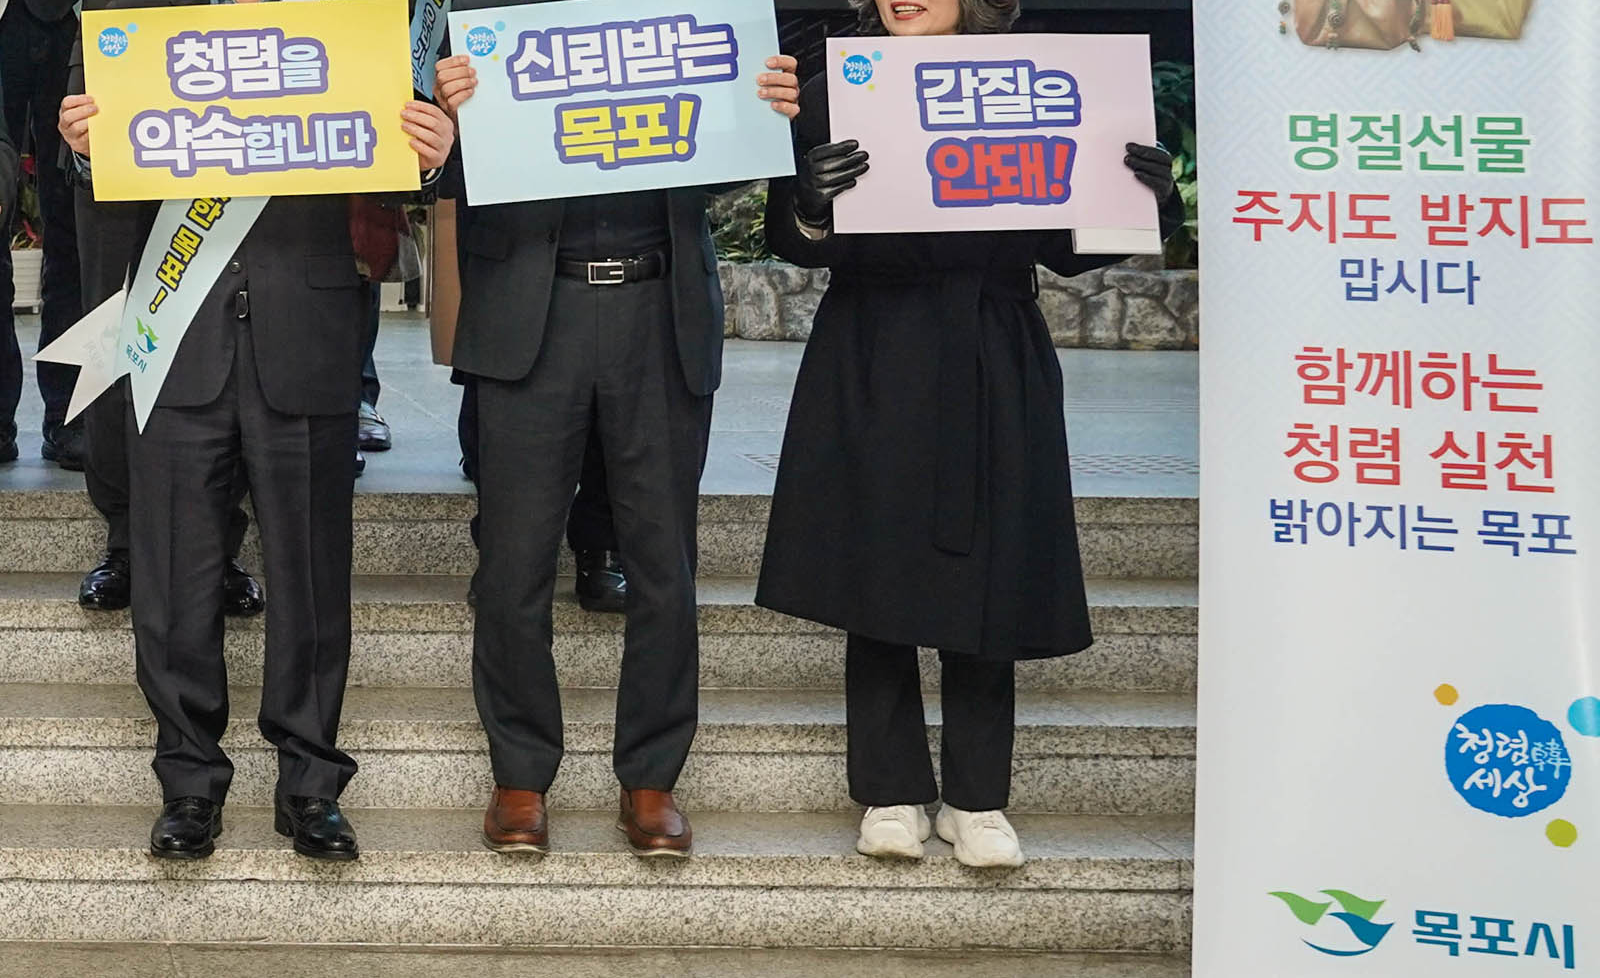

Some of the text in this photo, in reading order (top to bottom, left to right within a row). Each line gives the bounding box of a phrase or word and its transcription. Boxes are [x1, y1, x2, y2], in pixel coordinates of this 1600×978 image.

[173, 35, 323, 95] 청렴을
[512, 21, 733, 95] 신뢰받는
[921, 67, 1075, 125] 갑질은
[135, 112, 371, 171] 약속합니다
[560, 100, 695, 164] 목포!
[1288, 112, 1531, 174] 명절선물
[933, 142, 1071, 201] 안돼!
[1232, 189, 1594, 249] 주지도 받지도
[1340, 257, 1481, 305] 맙시다
[1294, 345, 1543, 414] 함께하는
[1283, 422, 1555, 494] 청렴 실천
[1269, 498, 1577, 557] 밝아지는 목포
[1463, 766, 1548, 808] 세상
[1412, 909, 1575, 969] 목포시
